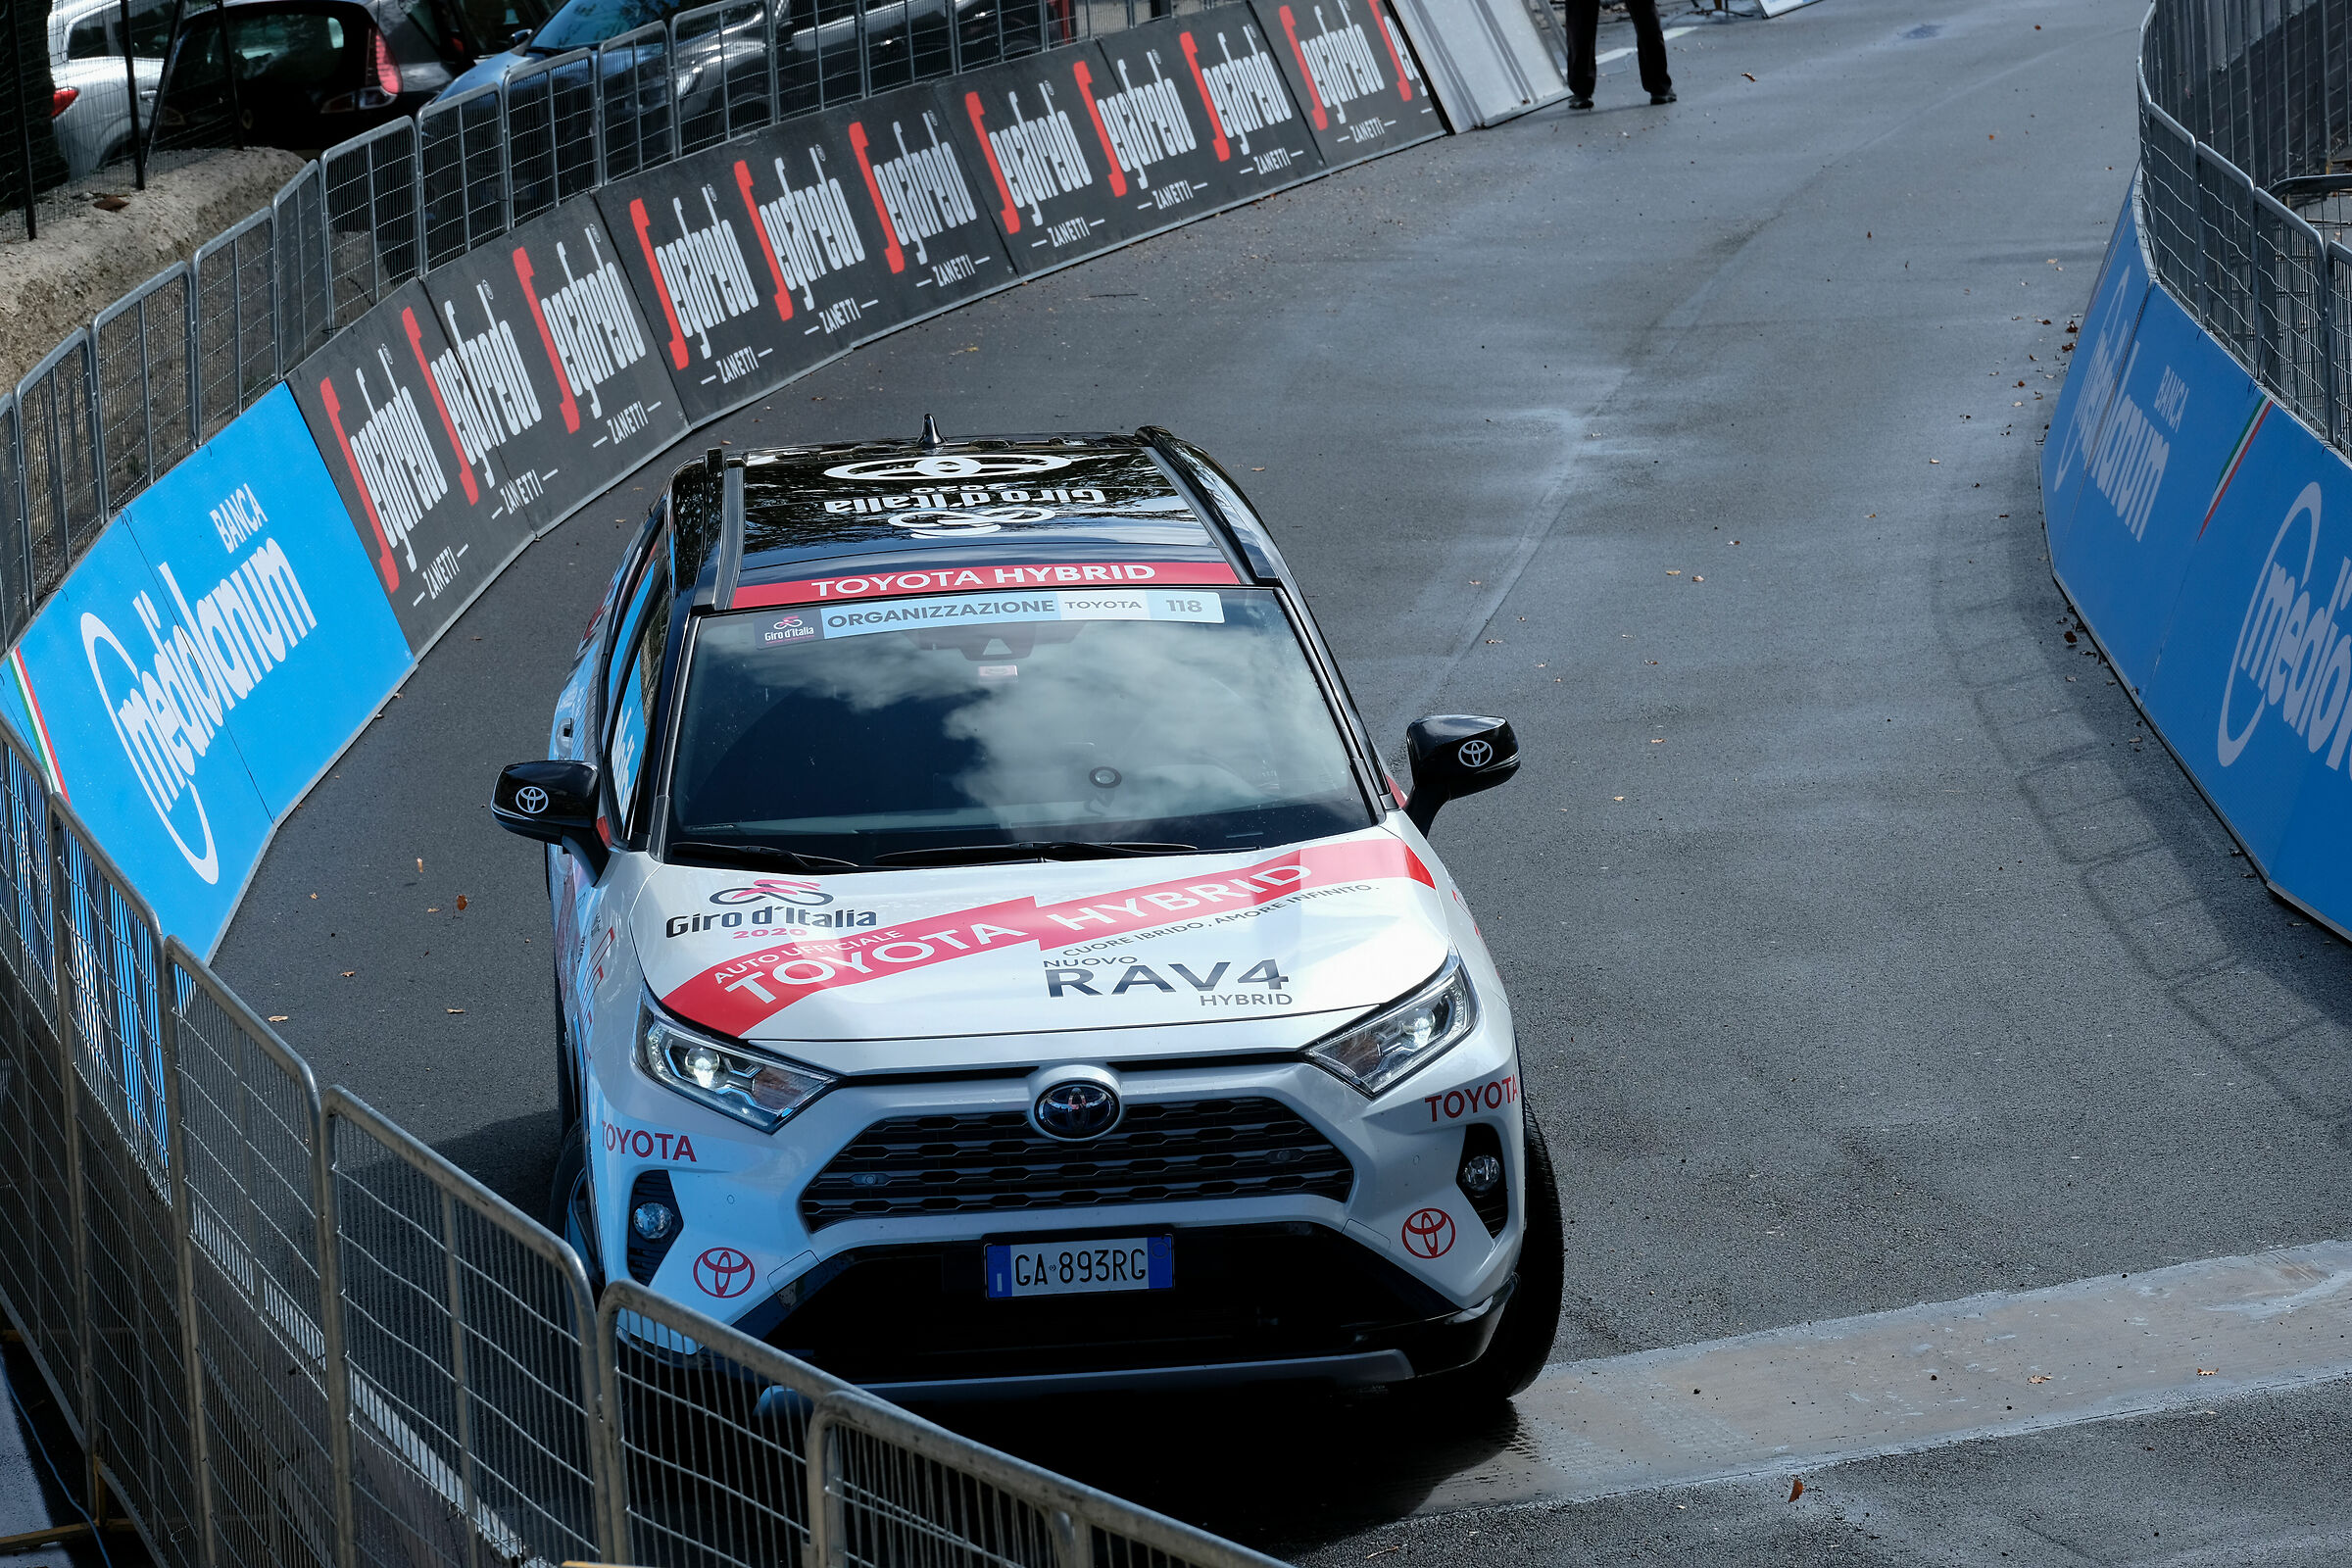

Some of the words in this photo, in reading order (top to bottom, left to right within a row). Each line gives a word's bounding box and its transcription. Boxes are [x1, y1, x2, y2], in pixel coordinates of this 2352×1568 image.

[1349, 117, 1385, 144] ZANETTI
[1253, 148, 1292, 175] ZANETTI
[1152, 179, 1194, 210] ZANETTI
[1047, 217, 1090, 247] ZANETTI
[932, 254, 976, 287] ZANETTI
[819, 297, 861, 334] ZANETTI
[715, 346, 760, 384] ZANETTI
[2154, 365, 2189, 434] BANCA
[607, 401, 649, 444] ZANETTI
[500, 469, 544, 514] ZANETTI
[911, 483, 1007, 493] 2020
[1003, 488, 1105, 504] Giro
[210, 483, 268, 554] BANCA
[422, 546, 460, 600] ZANETTI
[810, 570, 982, 597] TOYOTA
[995, 564, 1155, 584] HYBRID
[827, 599, 1055, 628] ORGANIZZAZIONE
[1064, 599, 1143, 610] TOYOTA
[1165, 599, 1202, 613] 118
[765, 631, 784, 641] Giro
[118, 538, 317, 811] mediolanum
[665, 909, 742, 939] Giro
[752, 906, 877, 928] d'Italia
[724, 923, 1029, 1004] TOYOTA
[1047, 864, 1312, 931] HYBRID
[733, 927, 808, 940] 2020
[1062, 936, 1135, 956] CUORE
[1214, 903, 1286, 924] AMORE
[713, 953, 780, 985] AUTO
[781, 930, 905, 956] UFFICIALE
[1043, 956, 1138, 967] NUOVO
[1046, 958, 1289, 998] RAV4
[1200, 993, 1293, 1006] HYBRID
[1425, 1074, 1518, 1122] TOYOTA
[602, 1119, 698, 1162] TOYOTA
